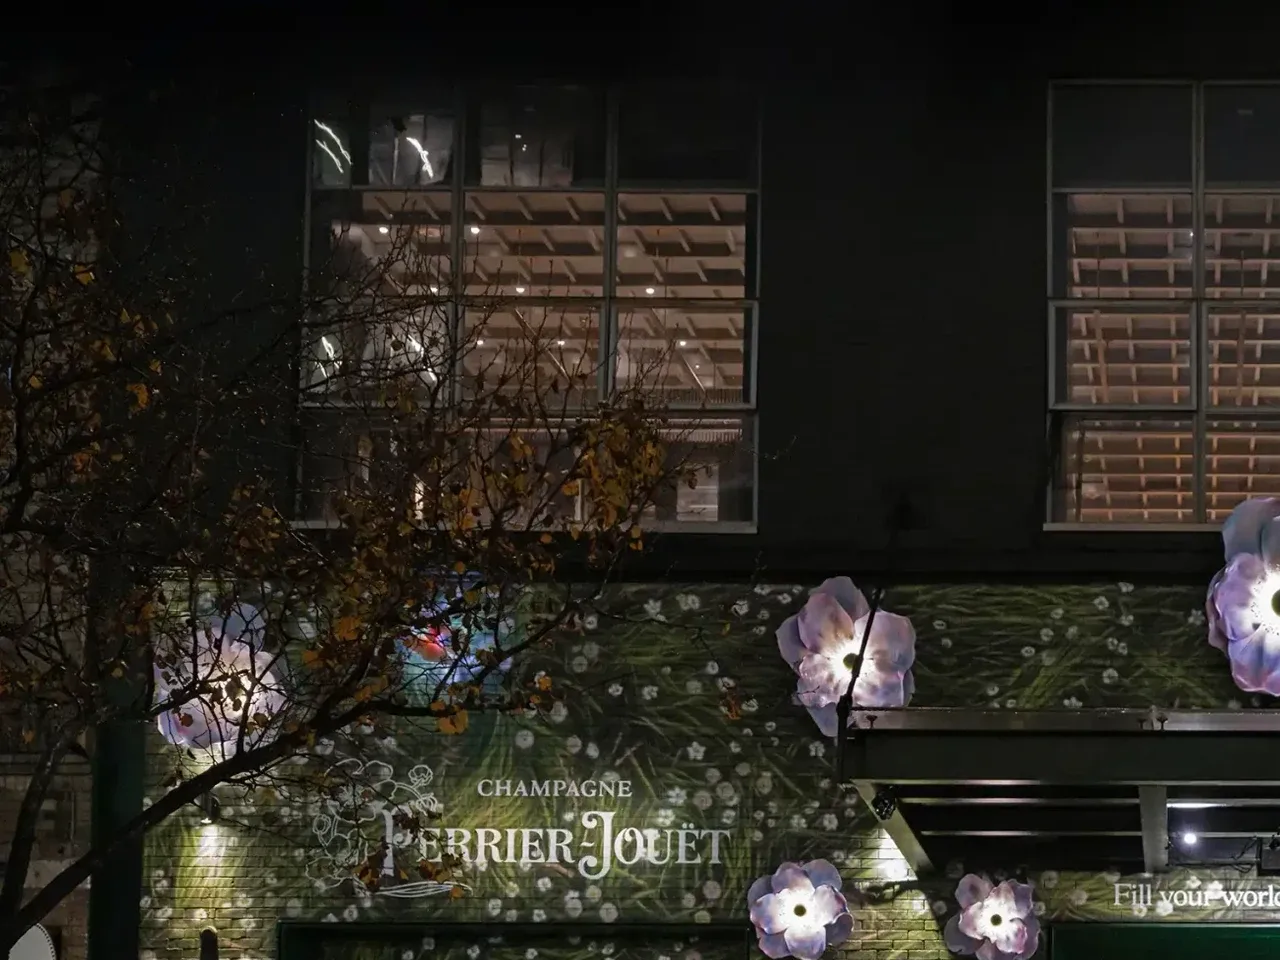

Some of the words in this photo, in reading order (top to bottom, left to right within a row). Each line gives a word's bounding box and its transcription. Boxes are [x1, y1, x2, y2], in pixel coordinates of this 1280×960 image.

[478, 780, 632, 797] CHAMPAGNE
[1113, 883, 1152, 906] Fill
[1160, 890, 1211, 907] your
